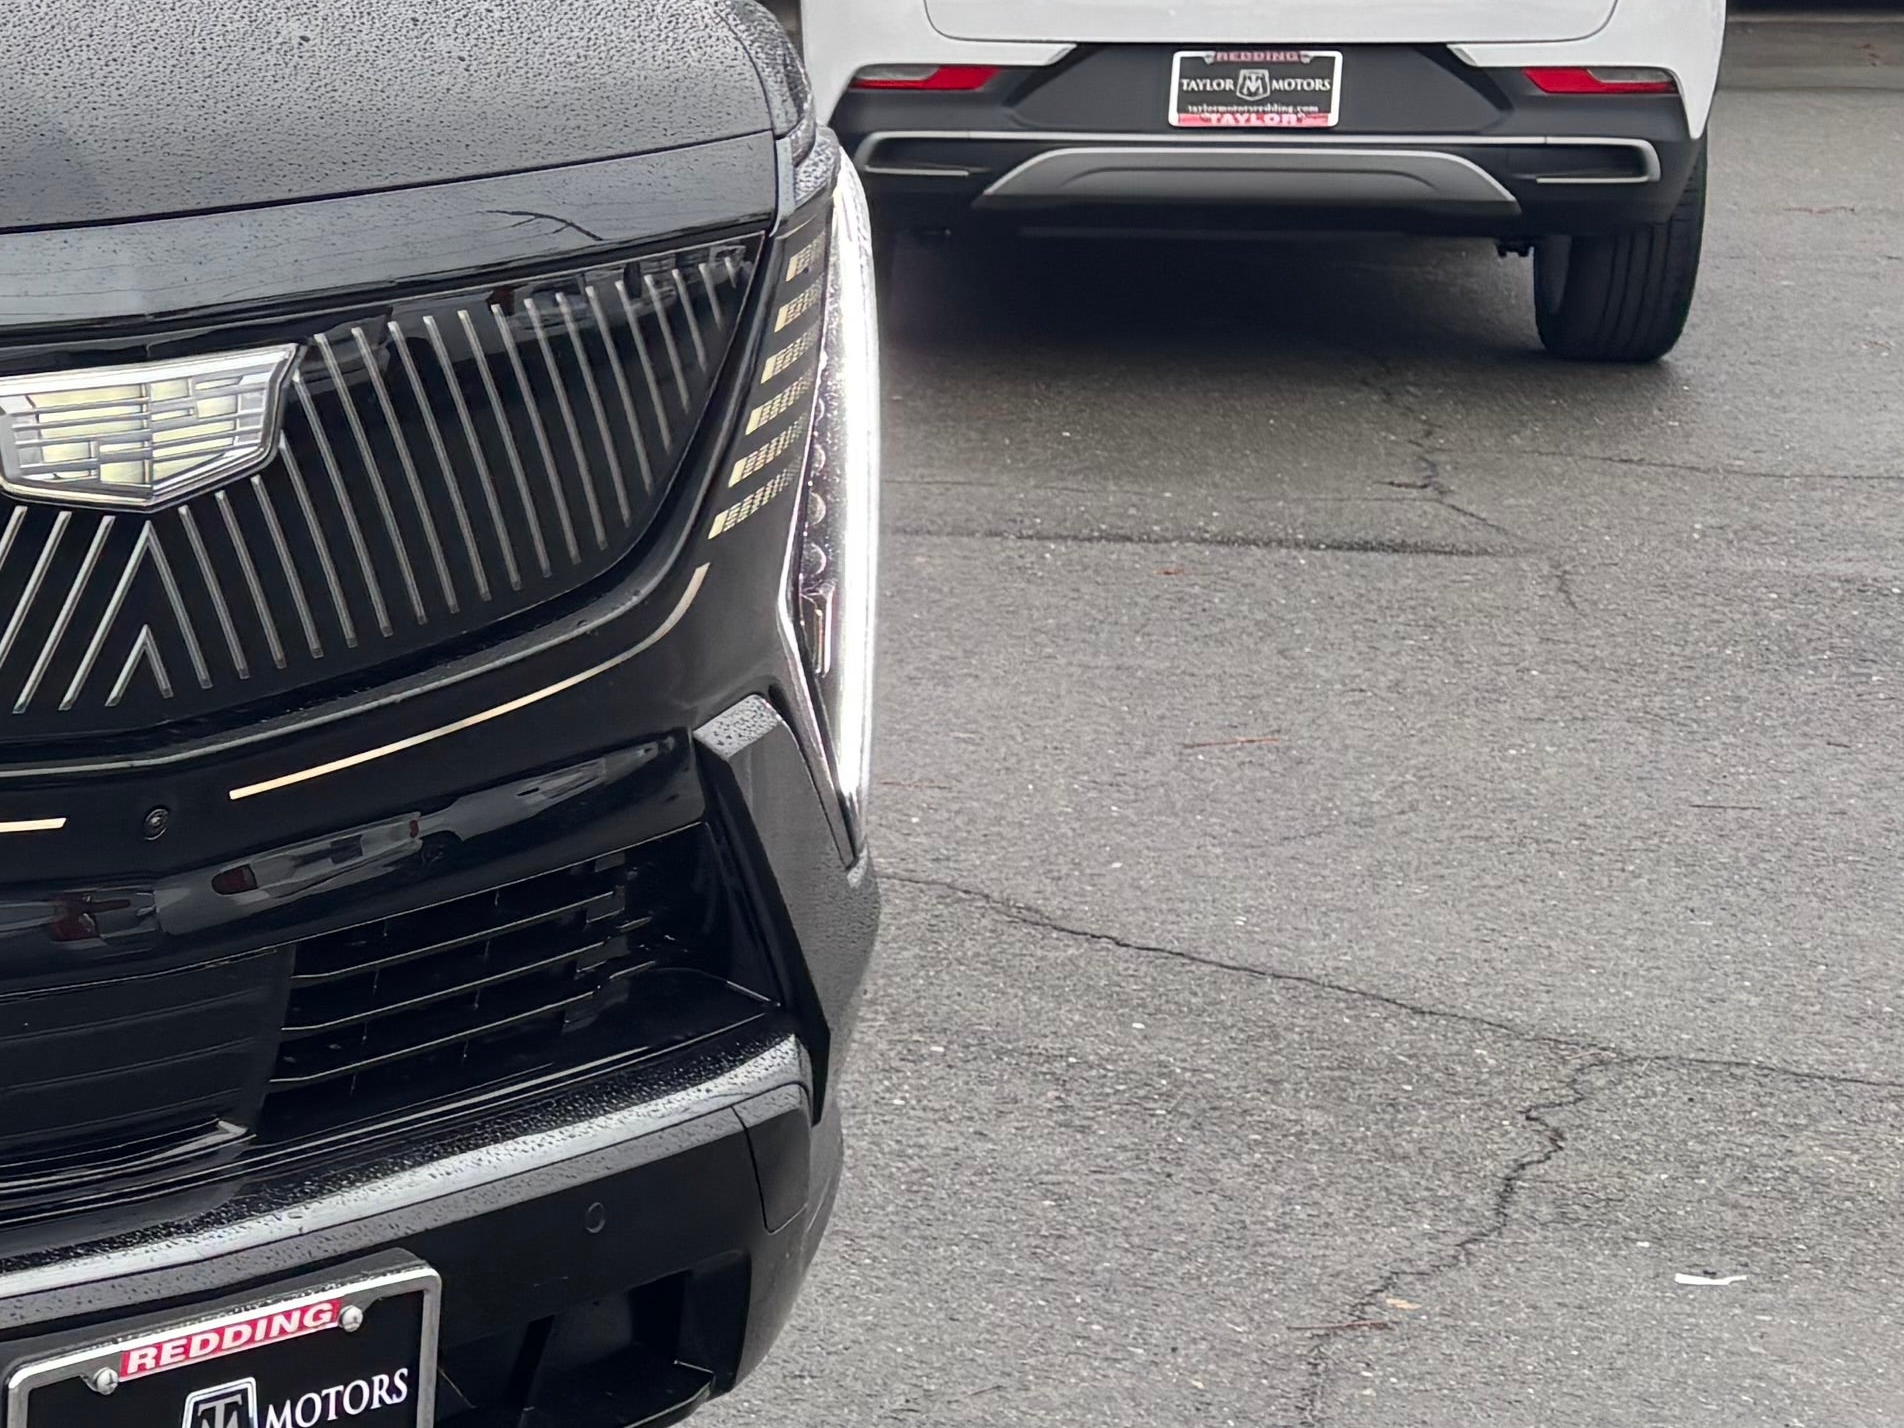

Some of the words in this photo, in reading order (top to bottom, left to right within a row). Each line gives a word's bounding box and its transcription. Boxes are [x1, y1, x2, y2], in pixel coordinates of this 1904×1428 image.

[1181, 78, 1235, 92] TAYLOR
[1271, 78, 1331, 92] MOTORS
[1207, 113, 1298, 126] TAYLOR
[126, 1301, 334, 1374] REDDING
